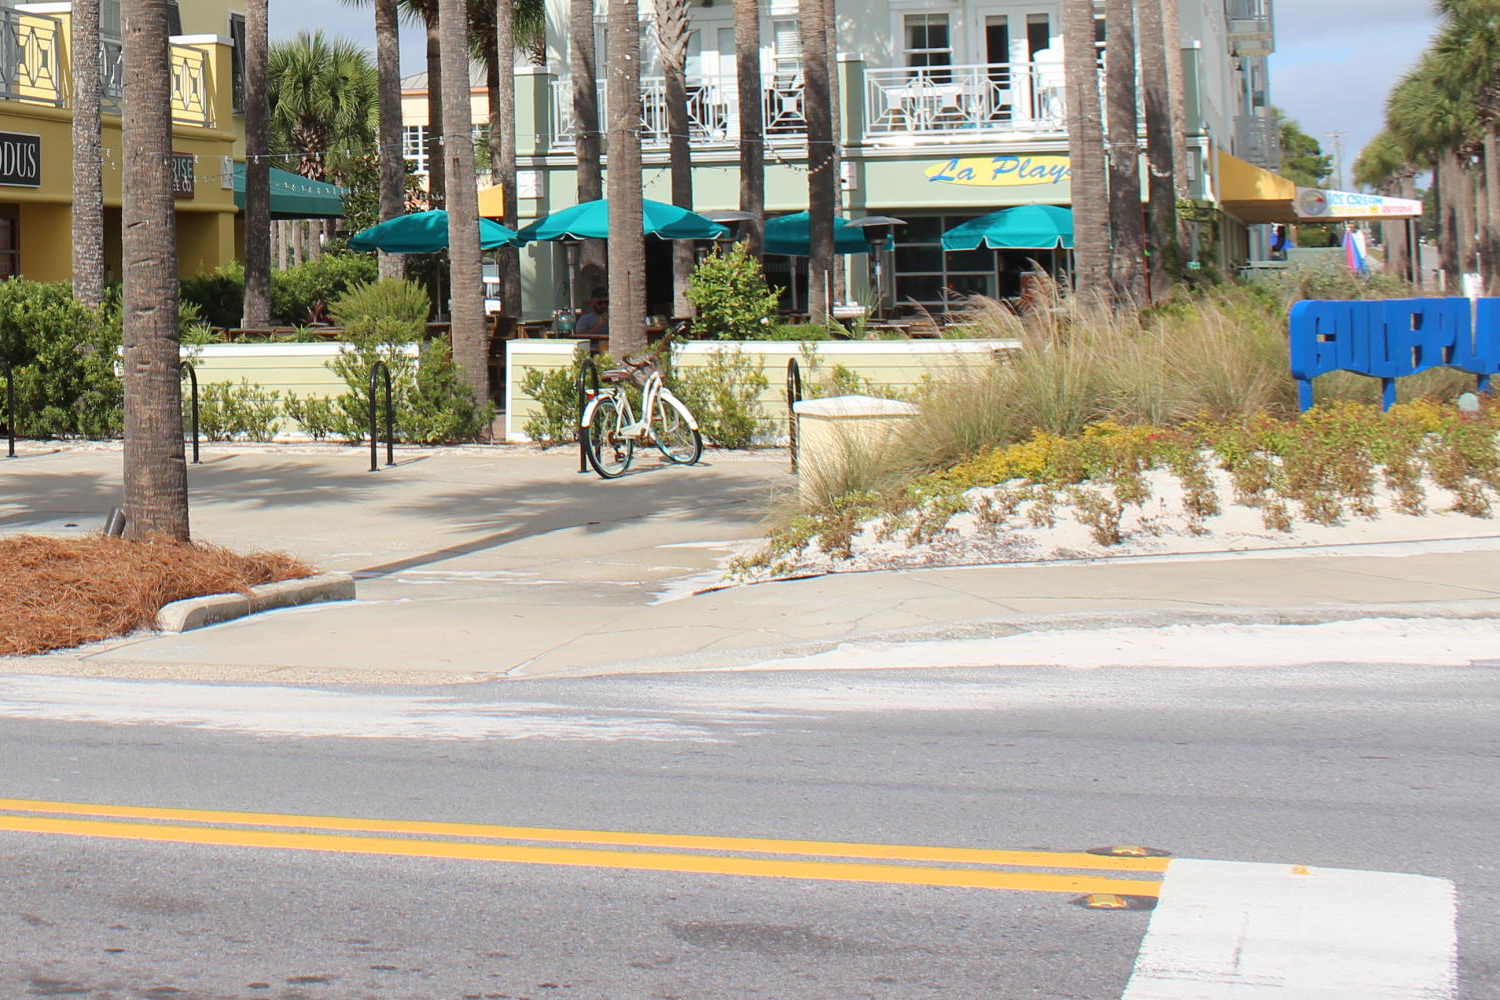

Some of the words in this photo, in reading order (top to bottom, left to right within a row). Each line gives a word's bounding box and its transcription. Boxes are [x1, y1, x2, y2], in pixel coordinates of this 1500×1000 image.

[172, 158, 192, 179] RISE
[929, 158, 976, 182] La
[992, 156, 1071, 184] Play
